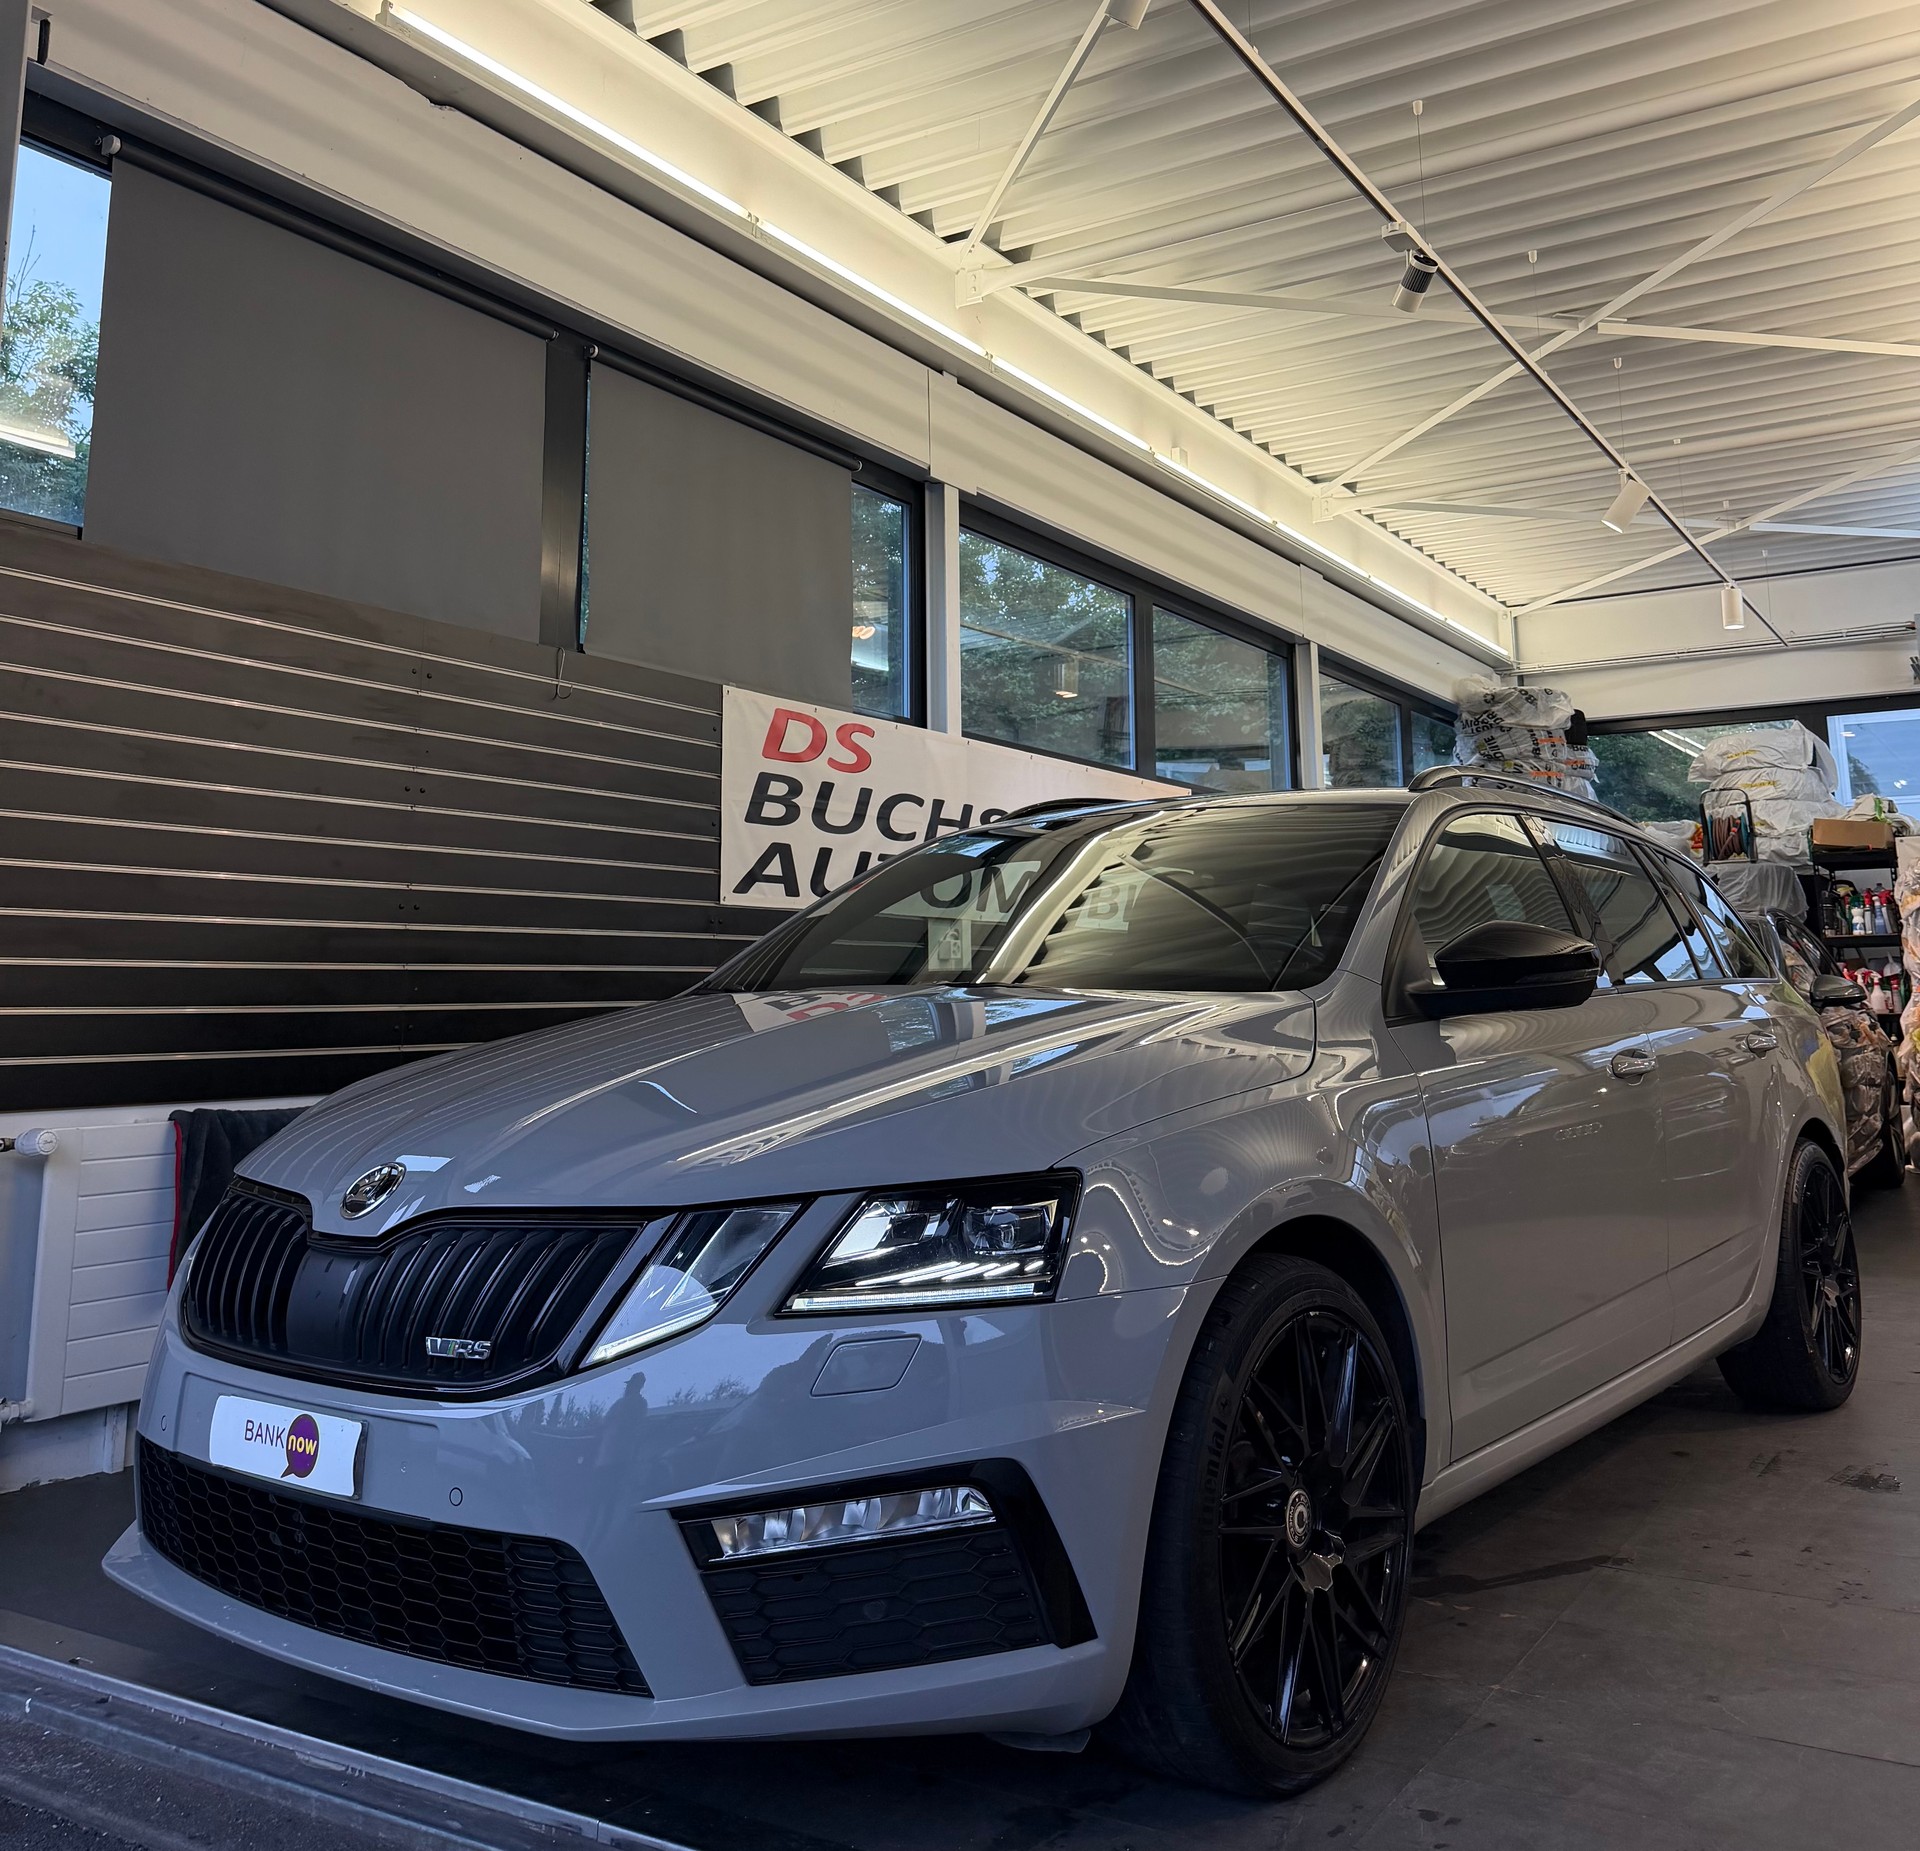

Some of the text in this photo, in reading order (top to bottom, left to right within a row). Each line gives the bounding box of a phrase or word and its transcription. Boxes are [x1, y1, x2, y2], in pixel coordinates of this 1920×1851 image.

[762, 708, 875, 773] DS
[244, 1419, 317, 1456] BANK now
